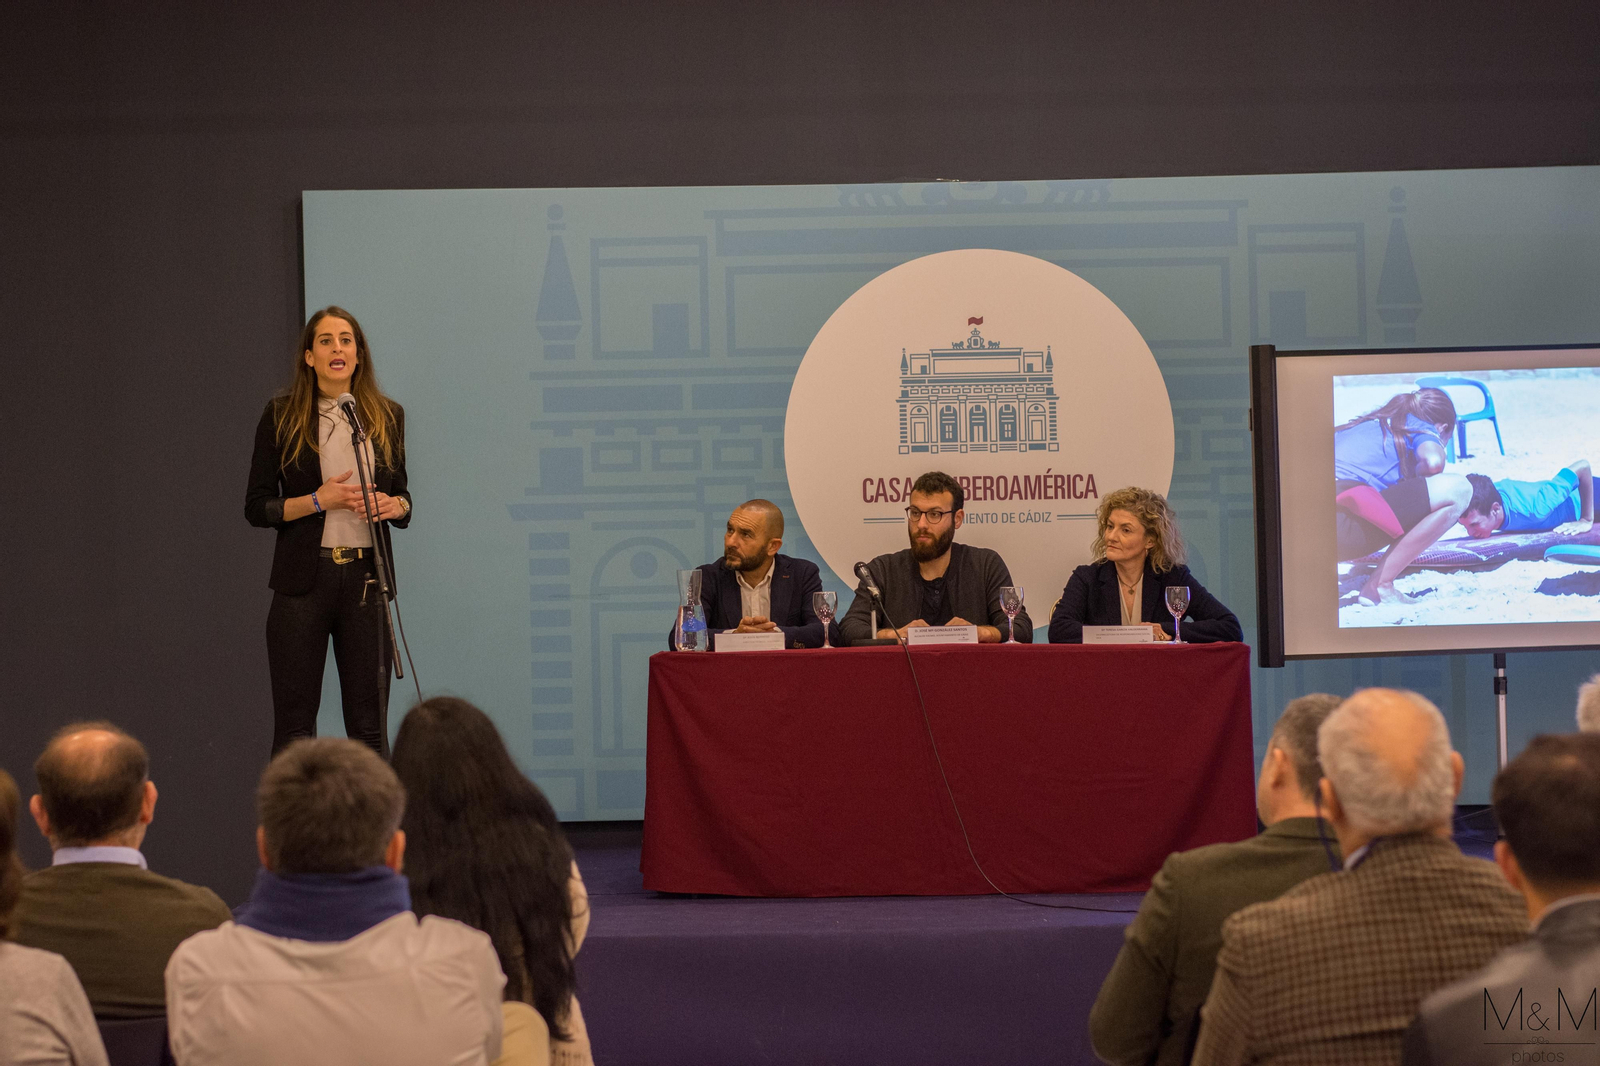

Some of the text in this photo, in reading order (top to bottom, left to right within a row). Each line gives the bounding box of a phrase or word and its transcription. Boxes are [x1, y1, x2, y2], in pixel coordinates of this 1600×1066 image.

[862, 468, 1098, 503] CASA BEROAMÉRICA
[1001, 512, 1015, 523] DE
[1018, 509, 1052, 523] CÁDIZ
